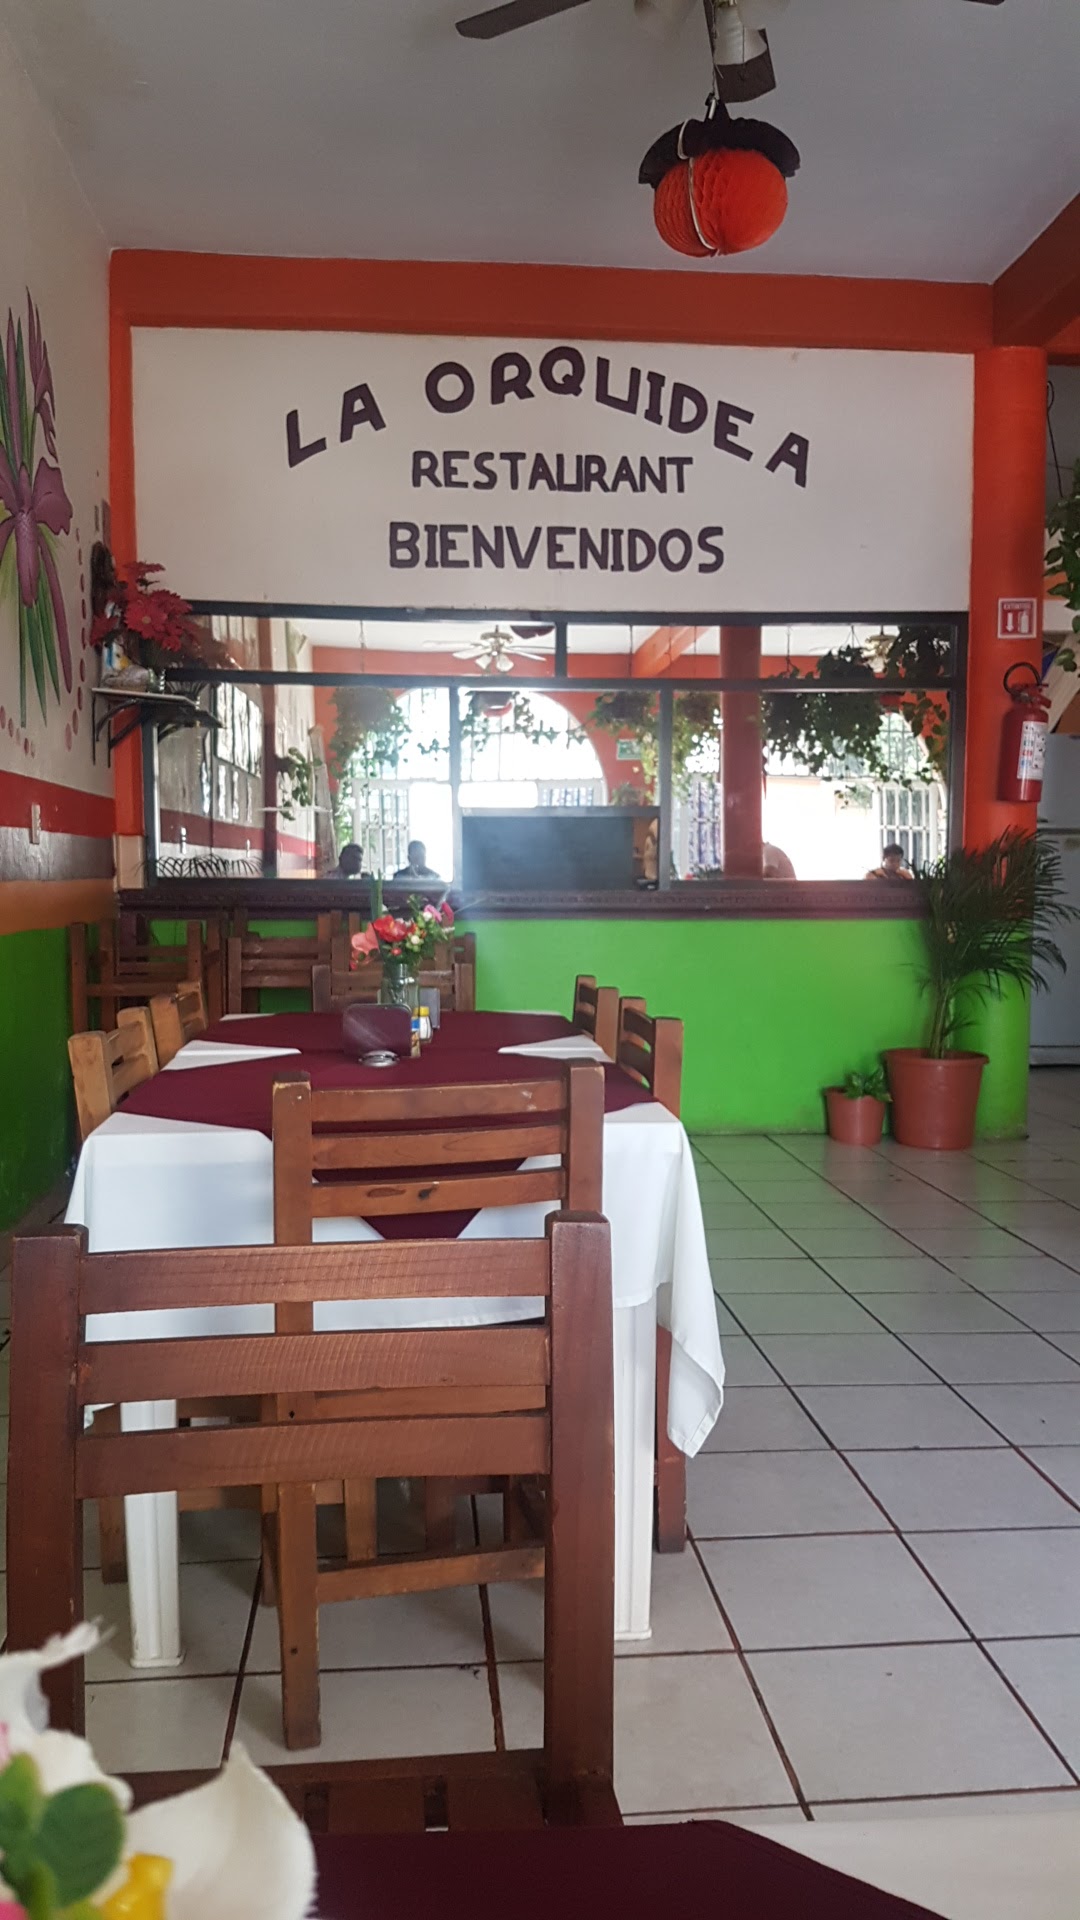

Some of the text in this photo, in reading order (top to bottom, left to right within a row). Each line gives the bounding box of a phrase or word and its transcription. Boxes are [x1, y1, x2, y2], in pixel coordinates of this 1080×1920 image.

[286, 346, 810, 488] LA ORQUIDEA
[411, 451, 694, 494] RESTAURANT
[389, 522, 724, 574] BIENVENIDOS
